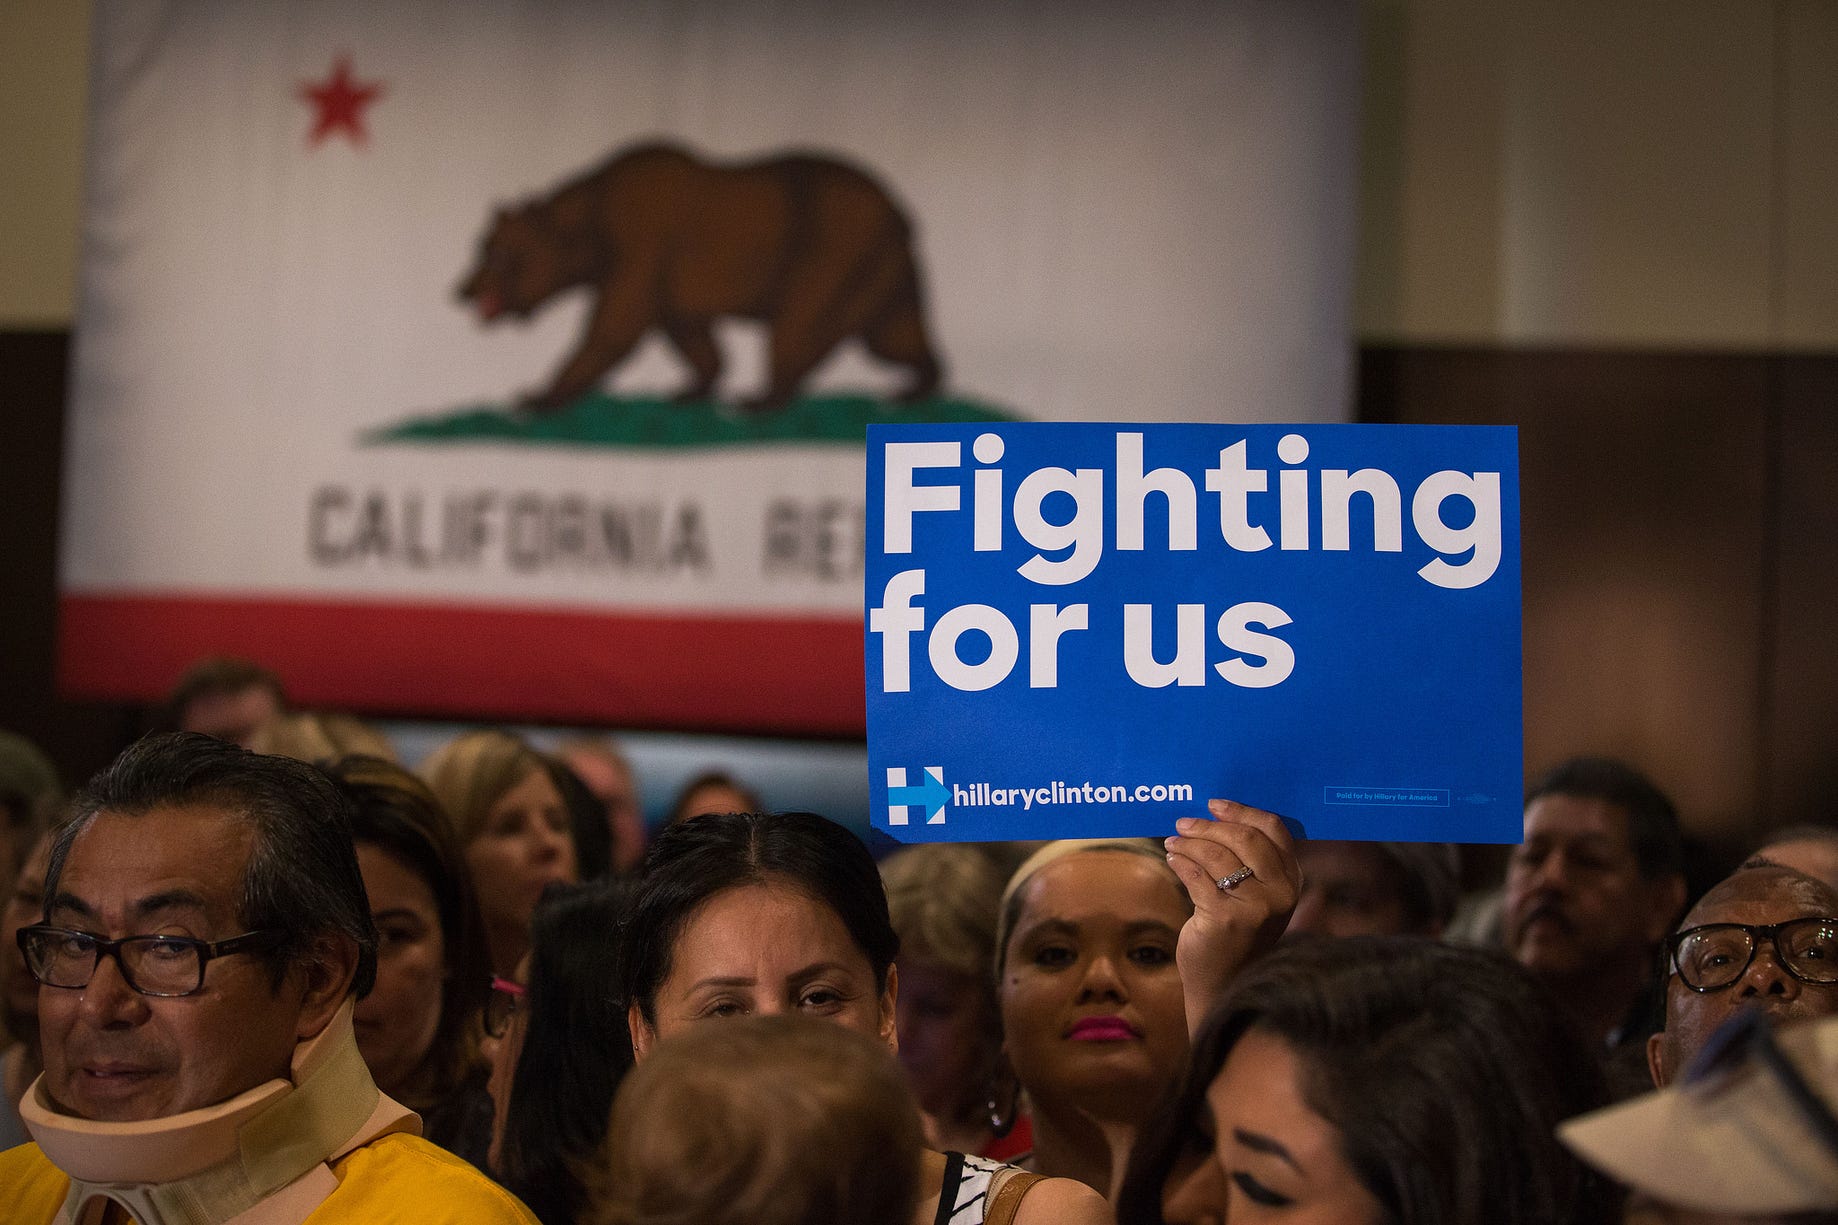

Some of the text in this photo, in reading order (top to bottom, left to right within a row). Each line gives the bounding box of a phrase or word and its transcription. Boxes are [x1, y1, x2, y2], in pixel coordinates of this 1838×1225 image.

[308, 486, 710, 576] CALIFORNIA
[884, 433, 1501, 588] Fighting
[870, 569, 1295, 692] for us
[954, 782, 1193, 810] hillaryclinton.com
[1374, 793, 1396, 801] Hillary
